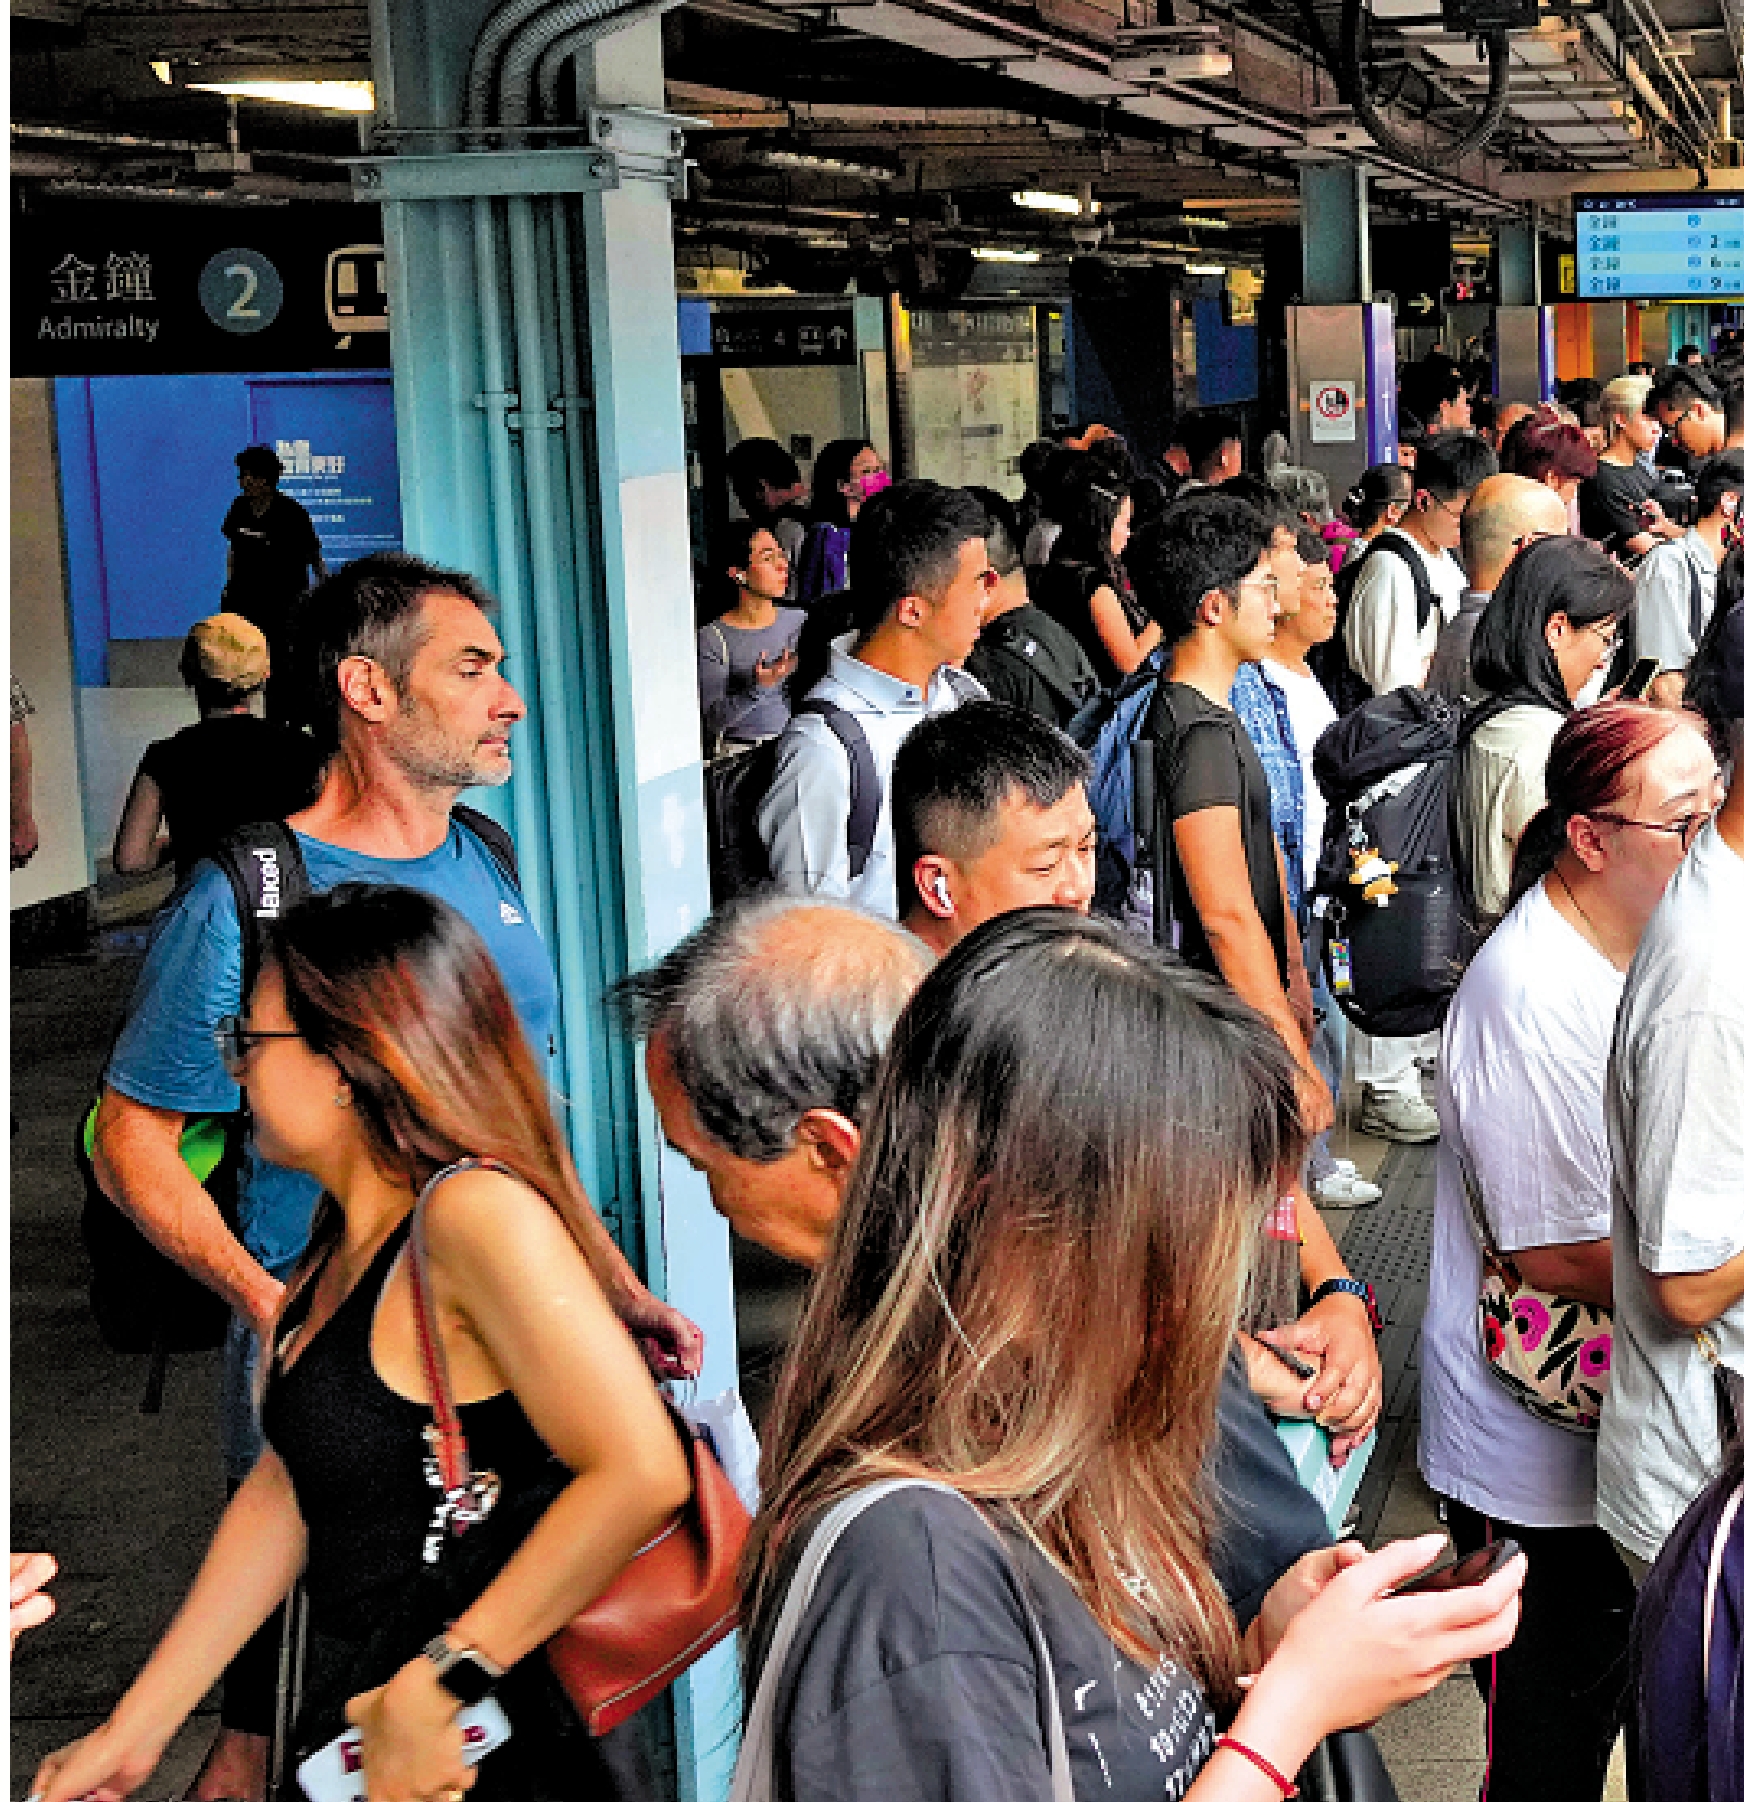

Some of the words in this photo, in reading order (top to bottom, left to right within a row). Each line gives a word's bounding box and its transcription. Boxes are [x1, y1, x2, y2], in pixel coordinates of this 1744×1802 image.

[50, 250, 156, 303] 金鐘
[223, 263, 262, 317] 2
[38, 313, 160, 343] Admiralty
